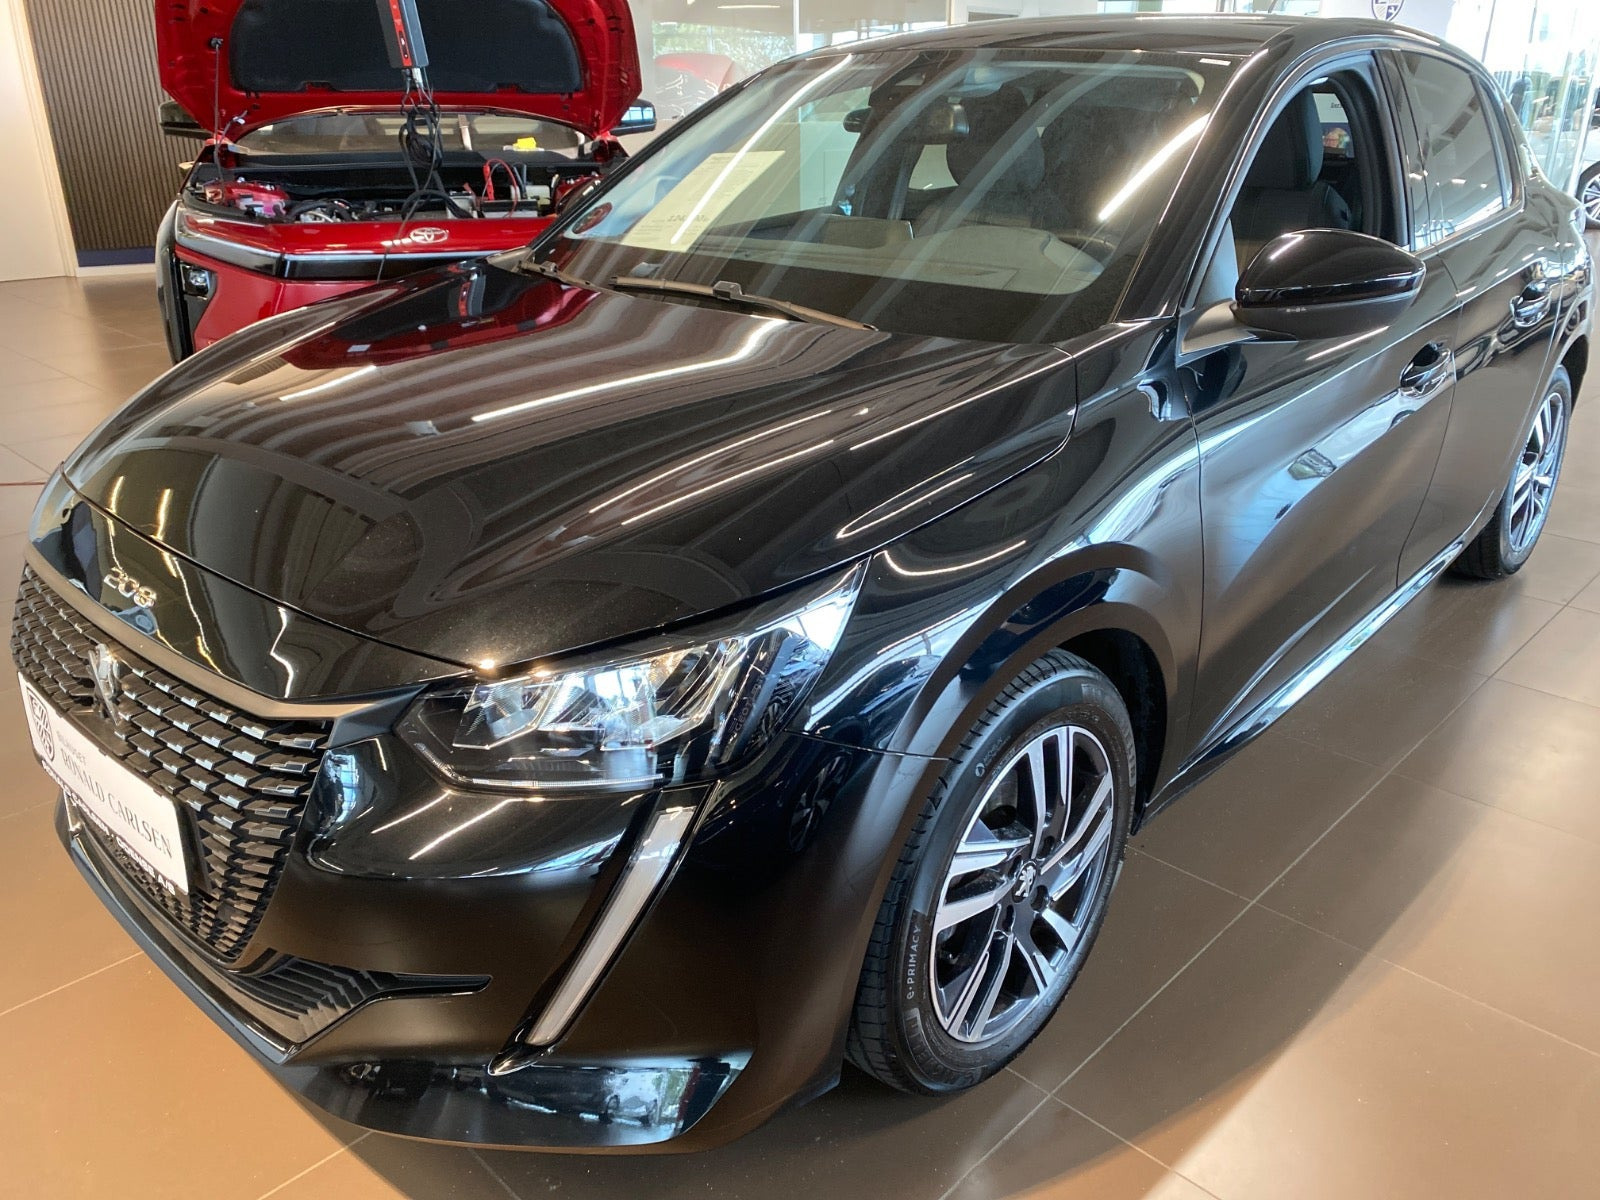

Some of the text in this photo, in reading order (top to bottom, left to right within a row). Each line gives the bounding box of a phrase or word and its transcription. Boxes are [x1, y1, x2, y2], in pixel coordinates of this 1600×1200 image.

[103, 566, 157, 608] 208
[60, 747, 172, 859] RONALD CARLSEN
